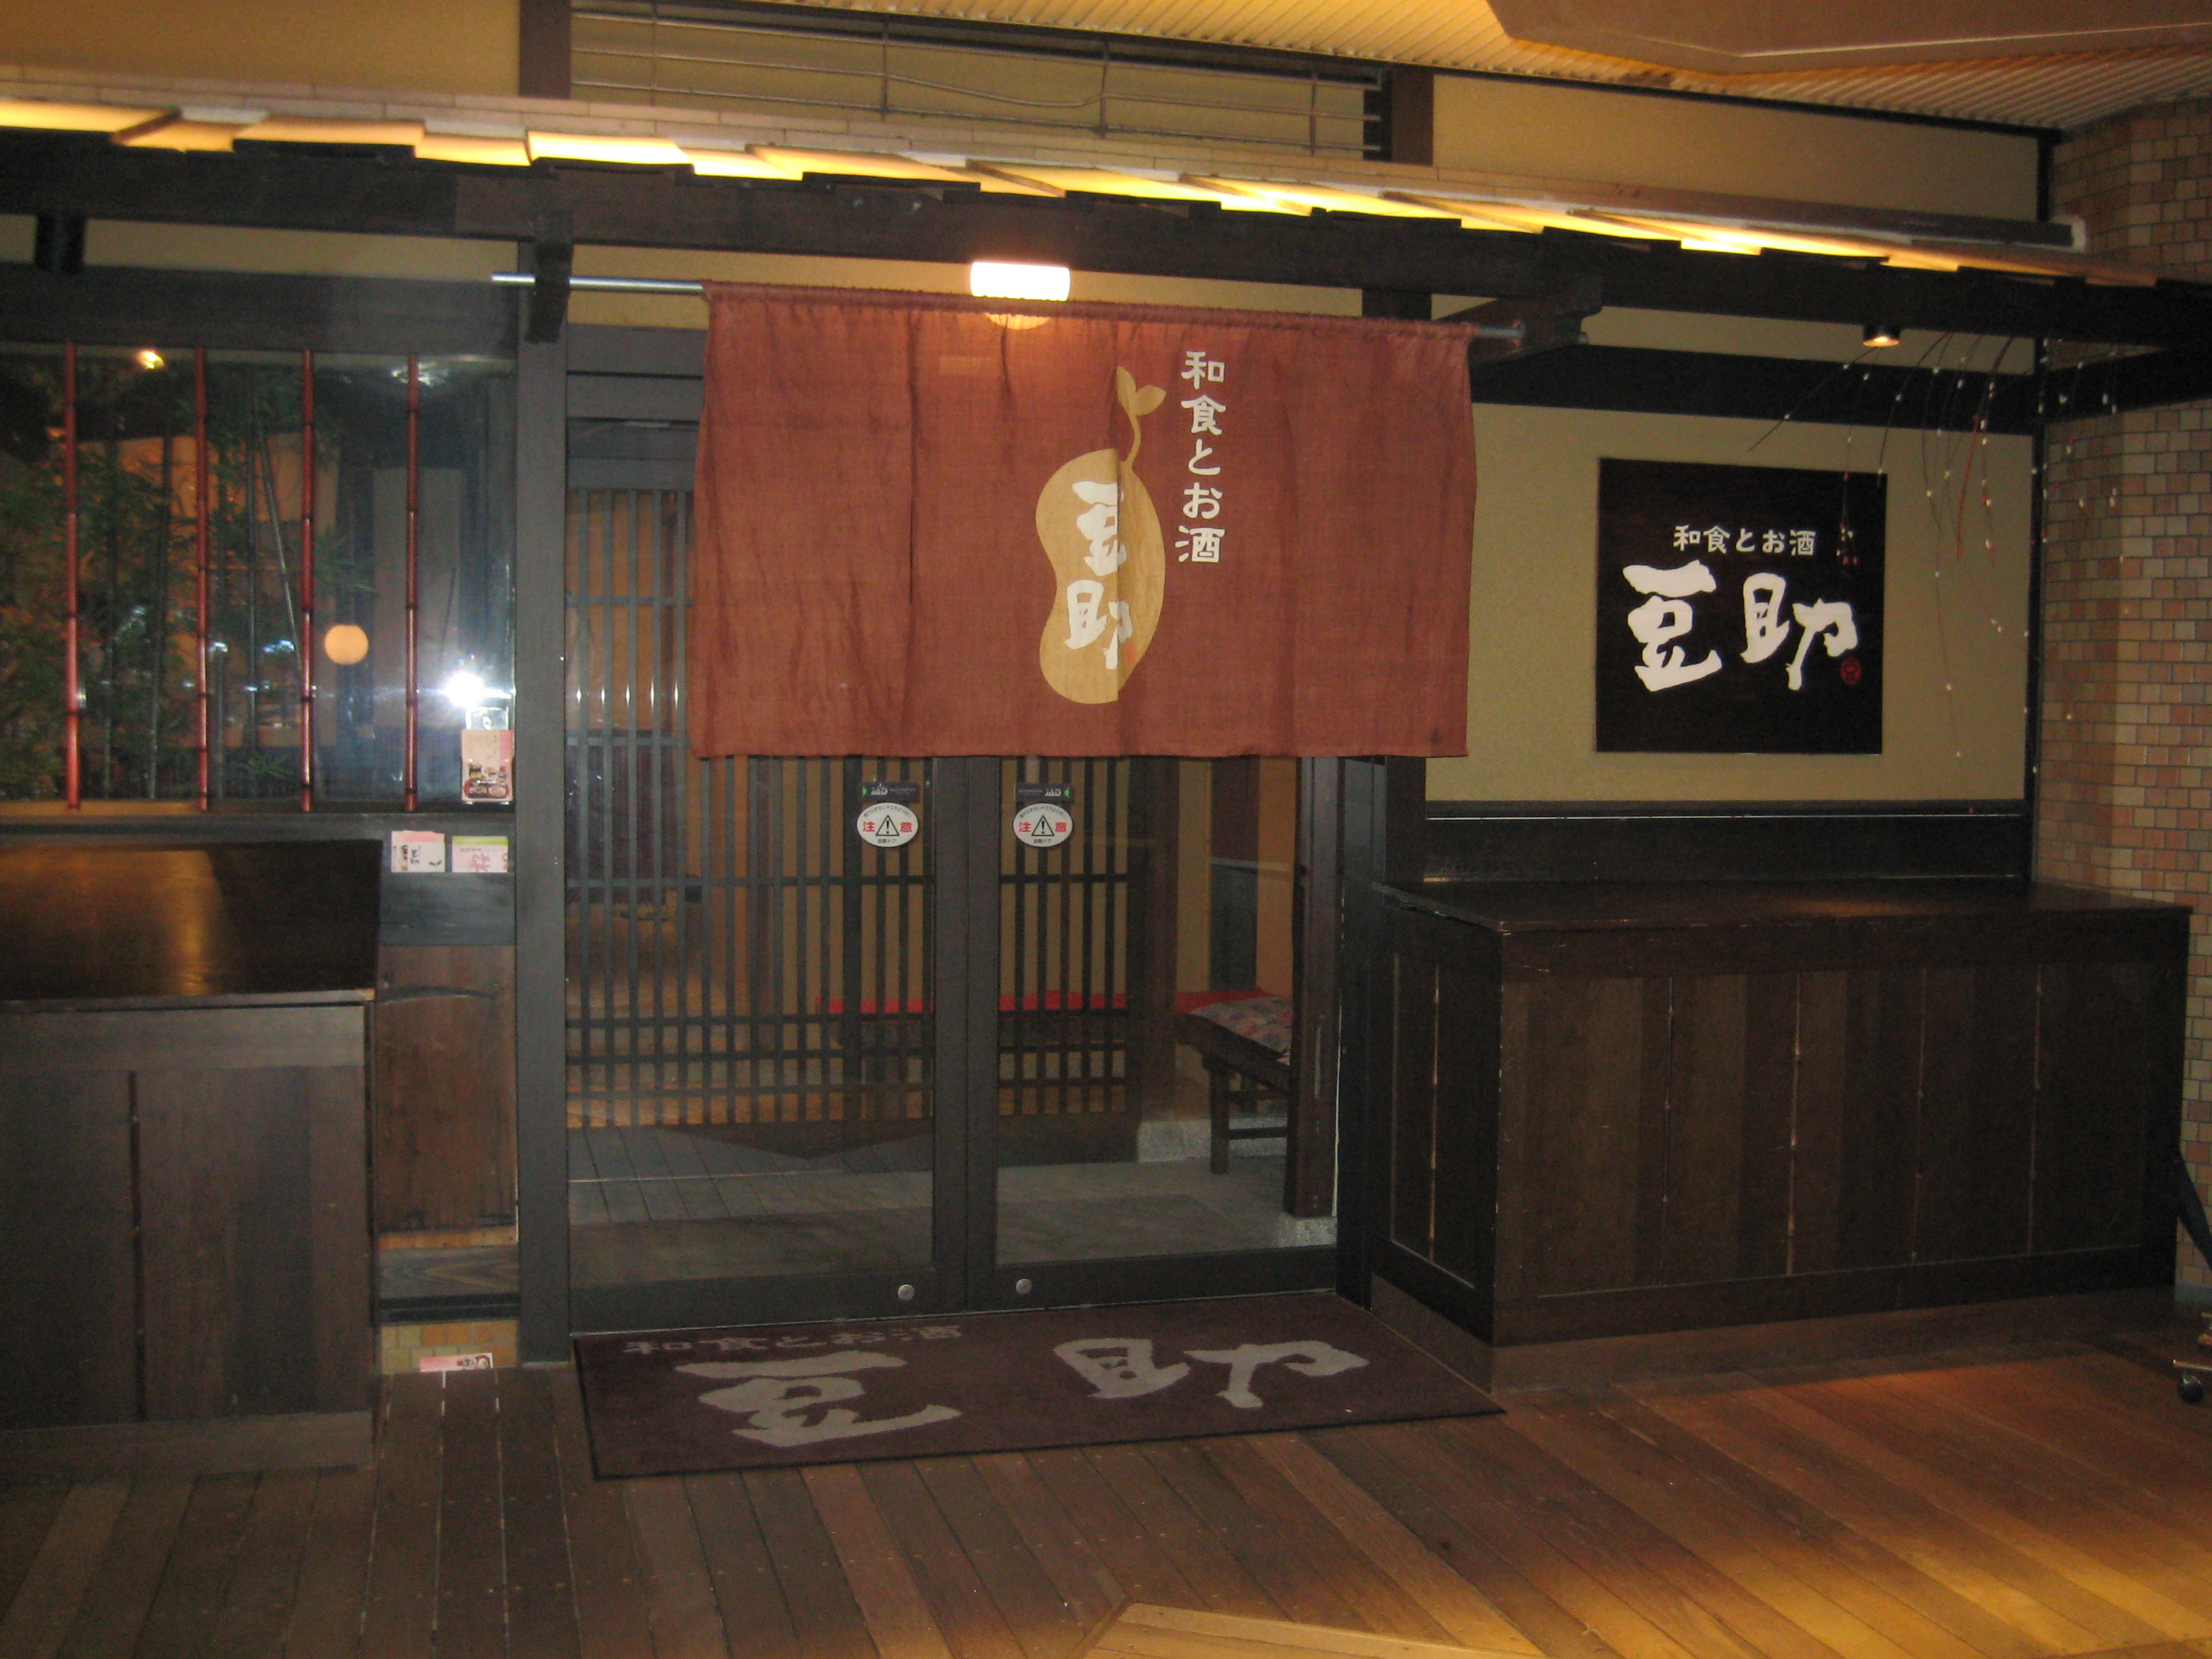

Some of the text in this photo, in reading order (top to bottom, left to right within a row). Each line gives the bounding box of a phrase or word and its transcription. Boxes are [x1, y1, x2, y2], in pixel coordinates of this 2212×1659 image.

[1174, 350, 1226, 564] 和食とお酒
[1672, 523, 1817, 557] 和食とお酒
[1622, 559, 1859, 693] 豆助
